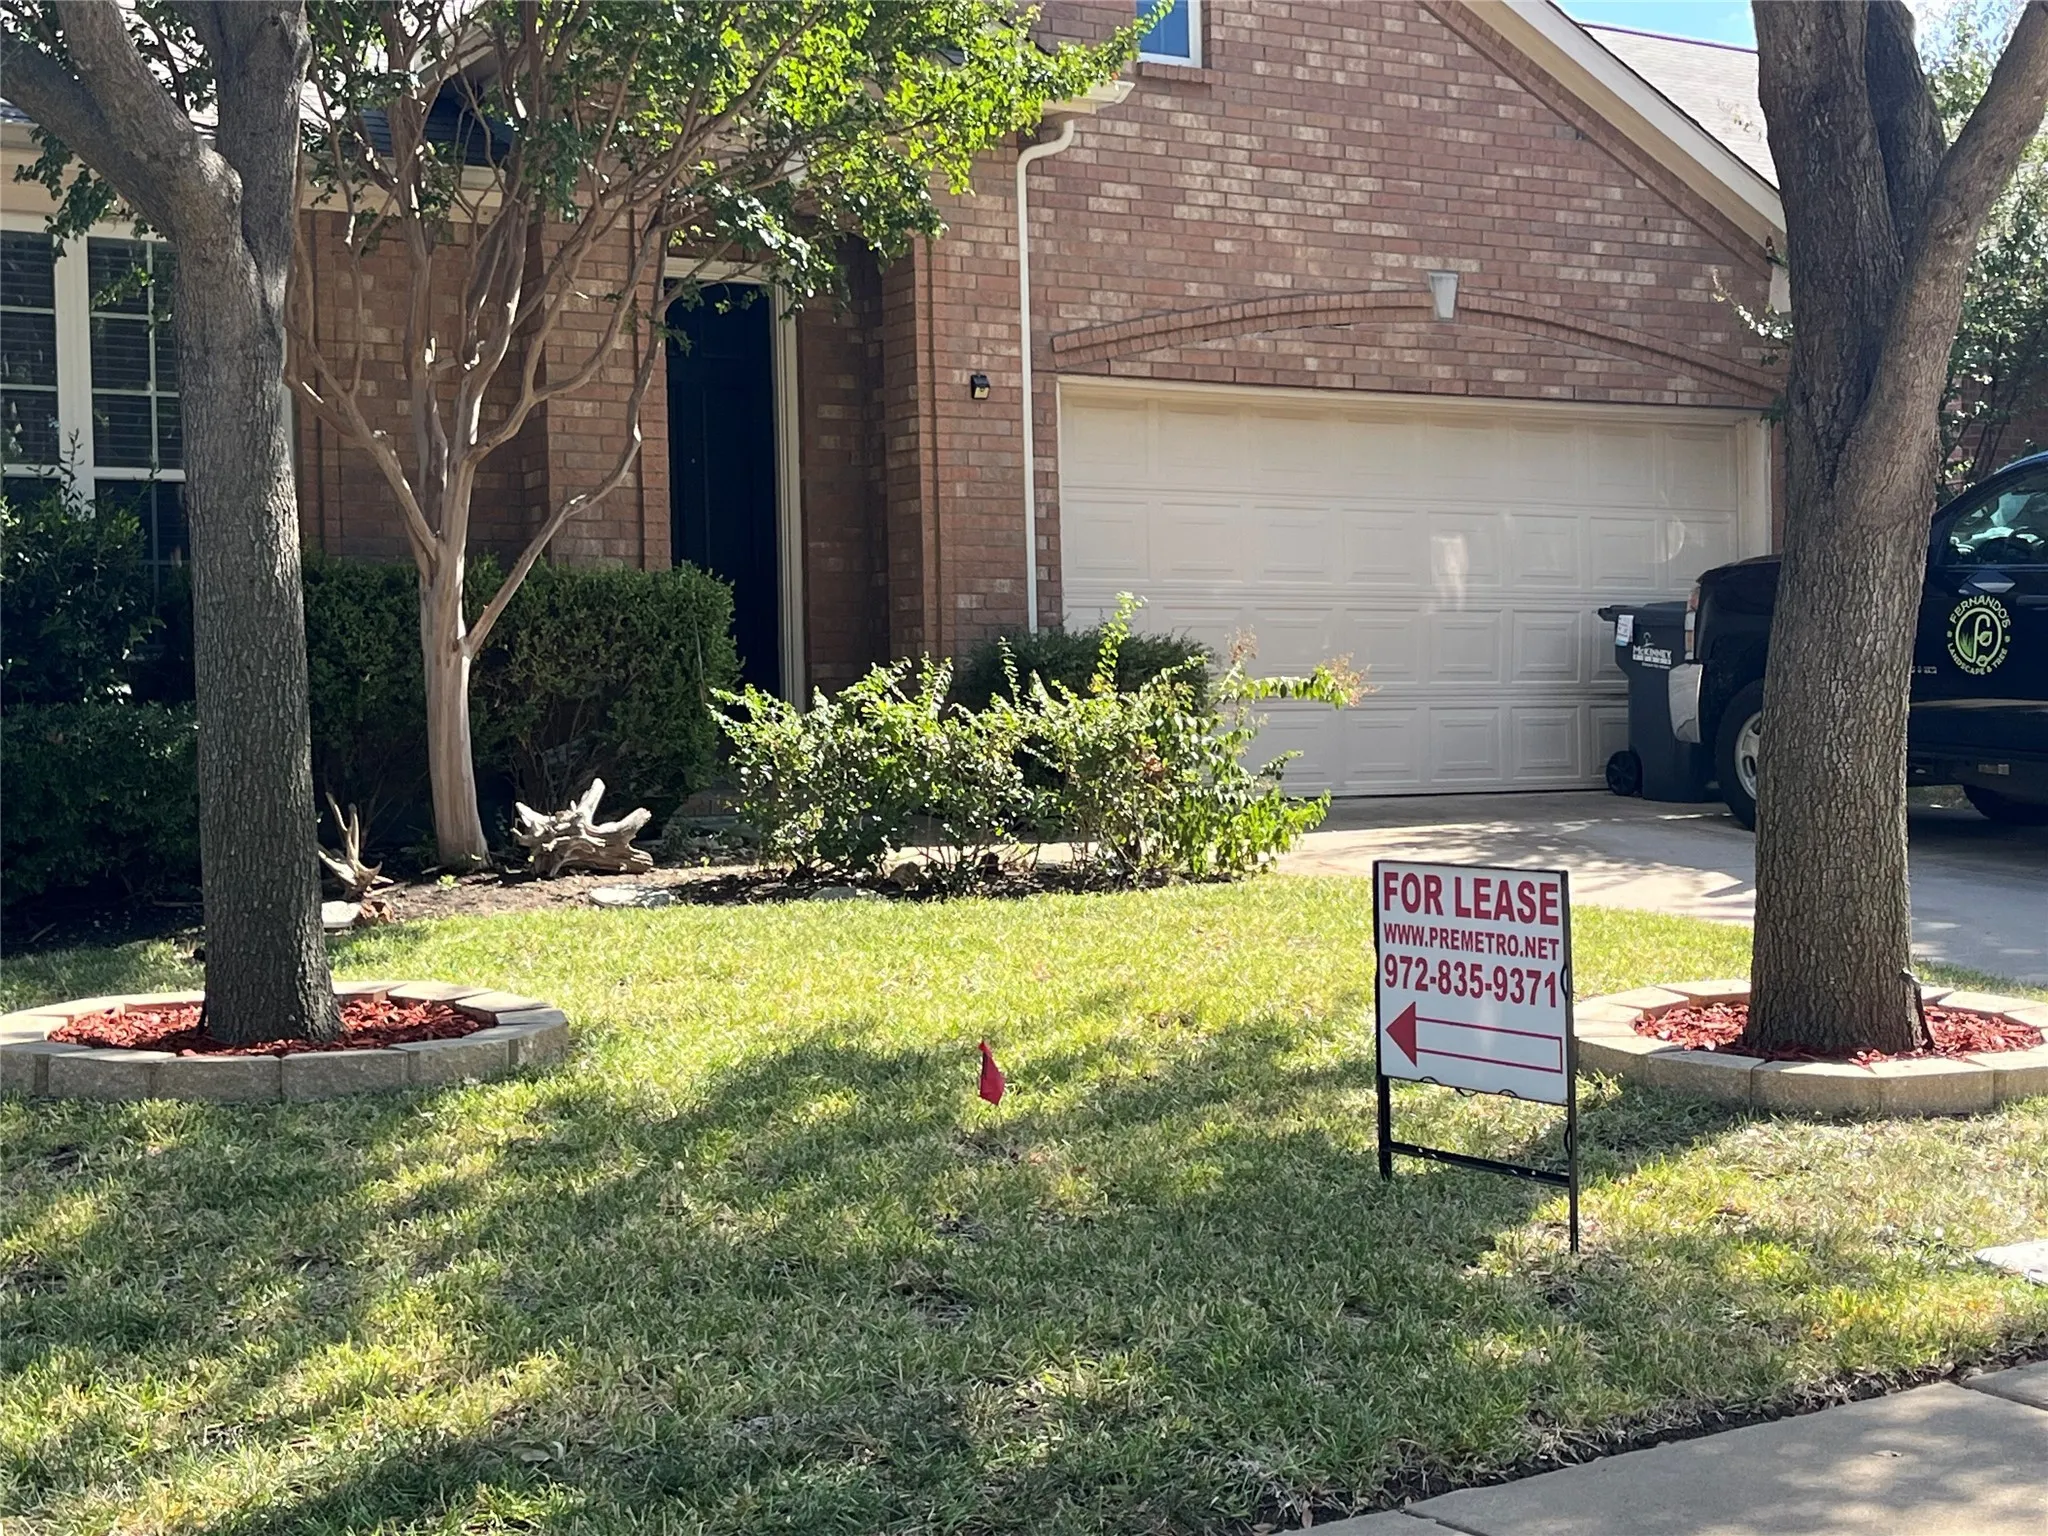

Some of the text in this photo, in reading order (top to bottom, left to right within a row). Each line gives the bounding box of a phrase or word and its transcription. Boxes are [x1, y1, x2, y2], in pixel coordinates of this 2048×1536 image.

[1949, 595, 2011, 628] FERNANDO'S
[1947, 643, 1985, 675] LANDSCAPE
[1992, 648, 2008, 668] TREE
[1383, 871, 1559, 926] FOR LEASE
[1383, 922, 1560, 961] WWW.PREMETRO.NET
[1384, 953, 1557, 1008] 972-835-9371
